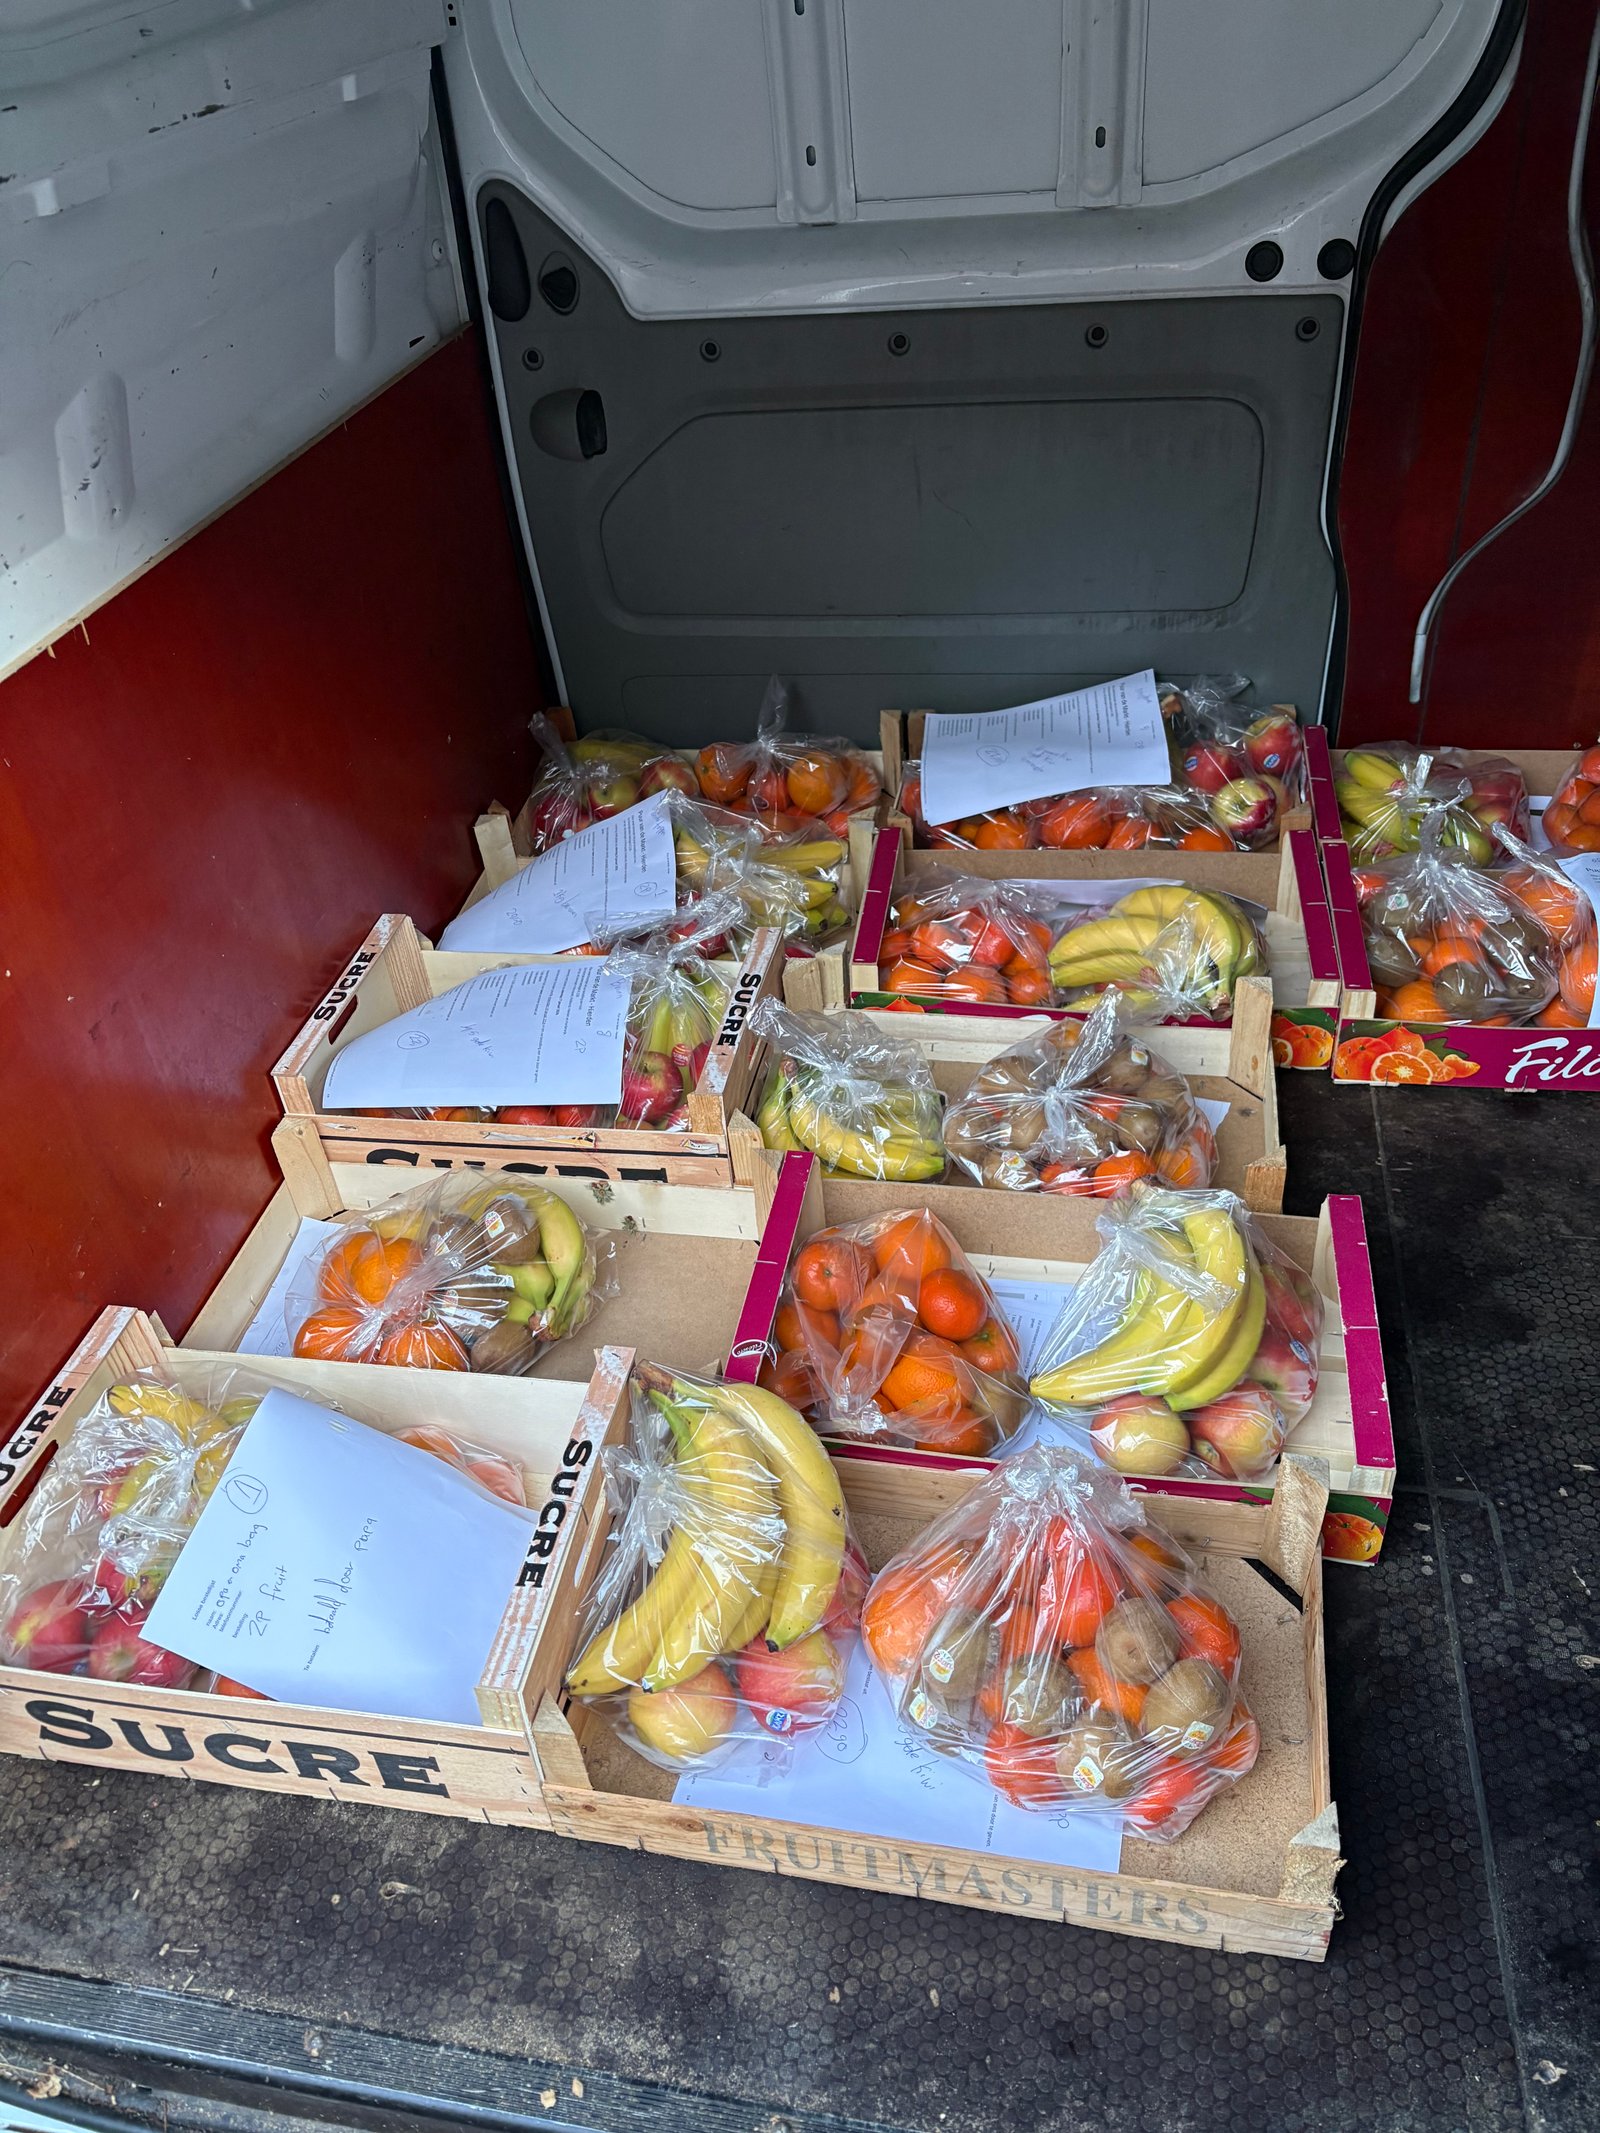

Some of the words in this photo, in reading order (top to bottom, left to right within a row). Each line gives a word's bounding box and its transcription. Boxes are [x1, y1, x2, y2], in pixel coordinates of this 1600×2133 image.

[314, 952, 377, 1021] SUCRE
[717, 972, 762, 1046] SUCRE
[515, 1438, 592, 1588] SUCRE
[259, 1566, 287, 1601] fruit
[24, 1698, 450, 1799] SUCRE
[910, 1756, 943, 1790] kiwi
[702, 1820, 1209, 1934] FRUITMASTERS
